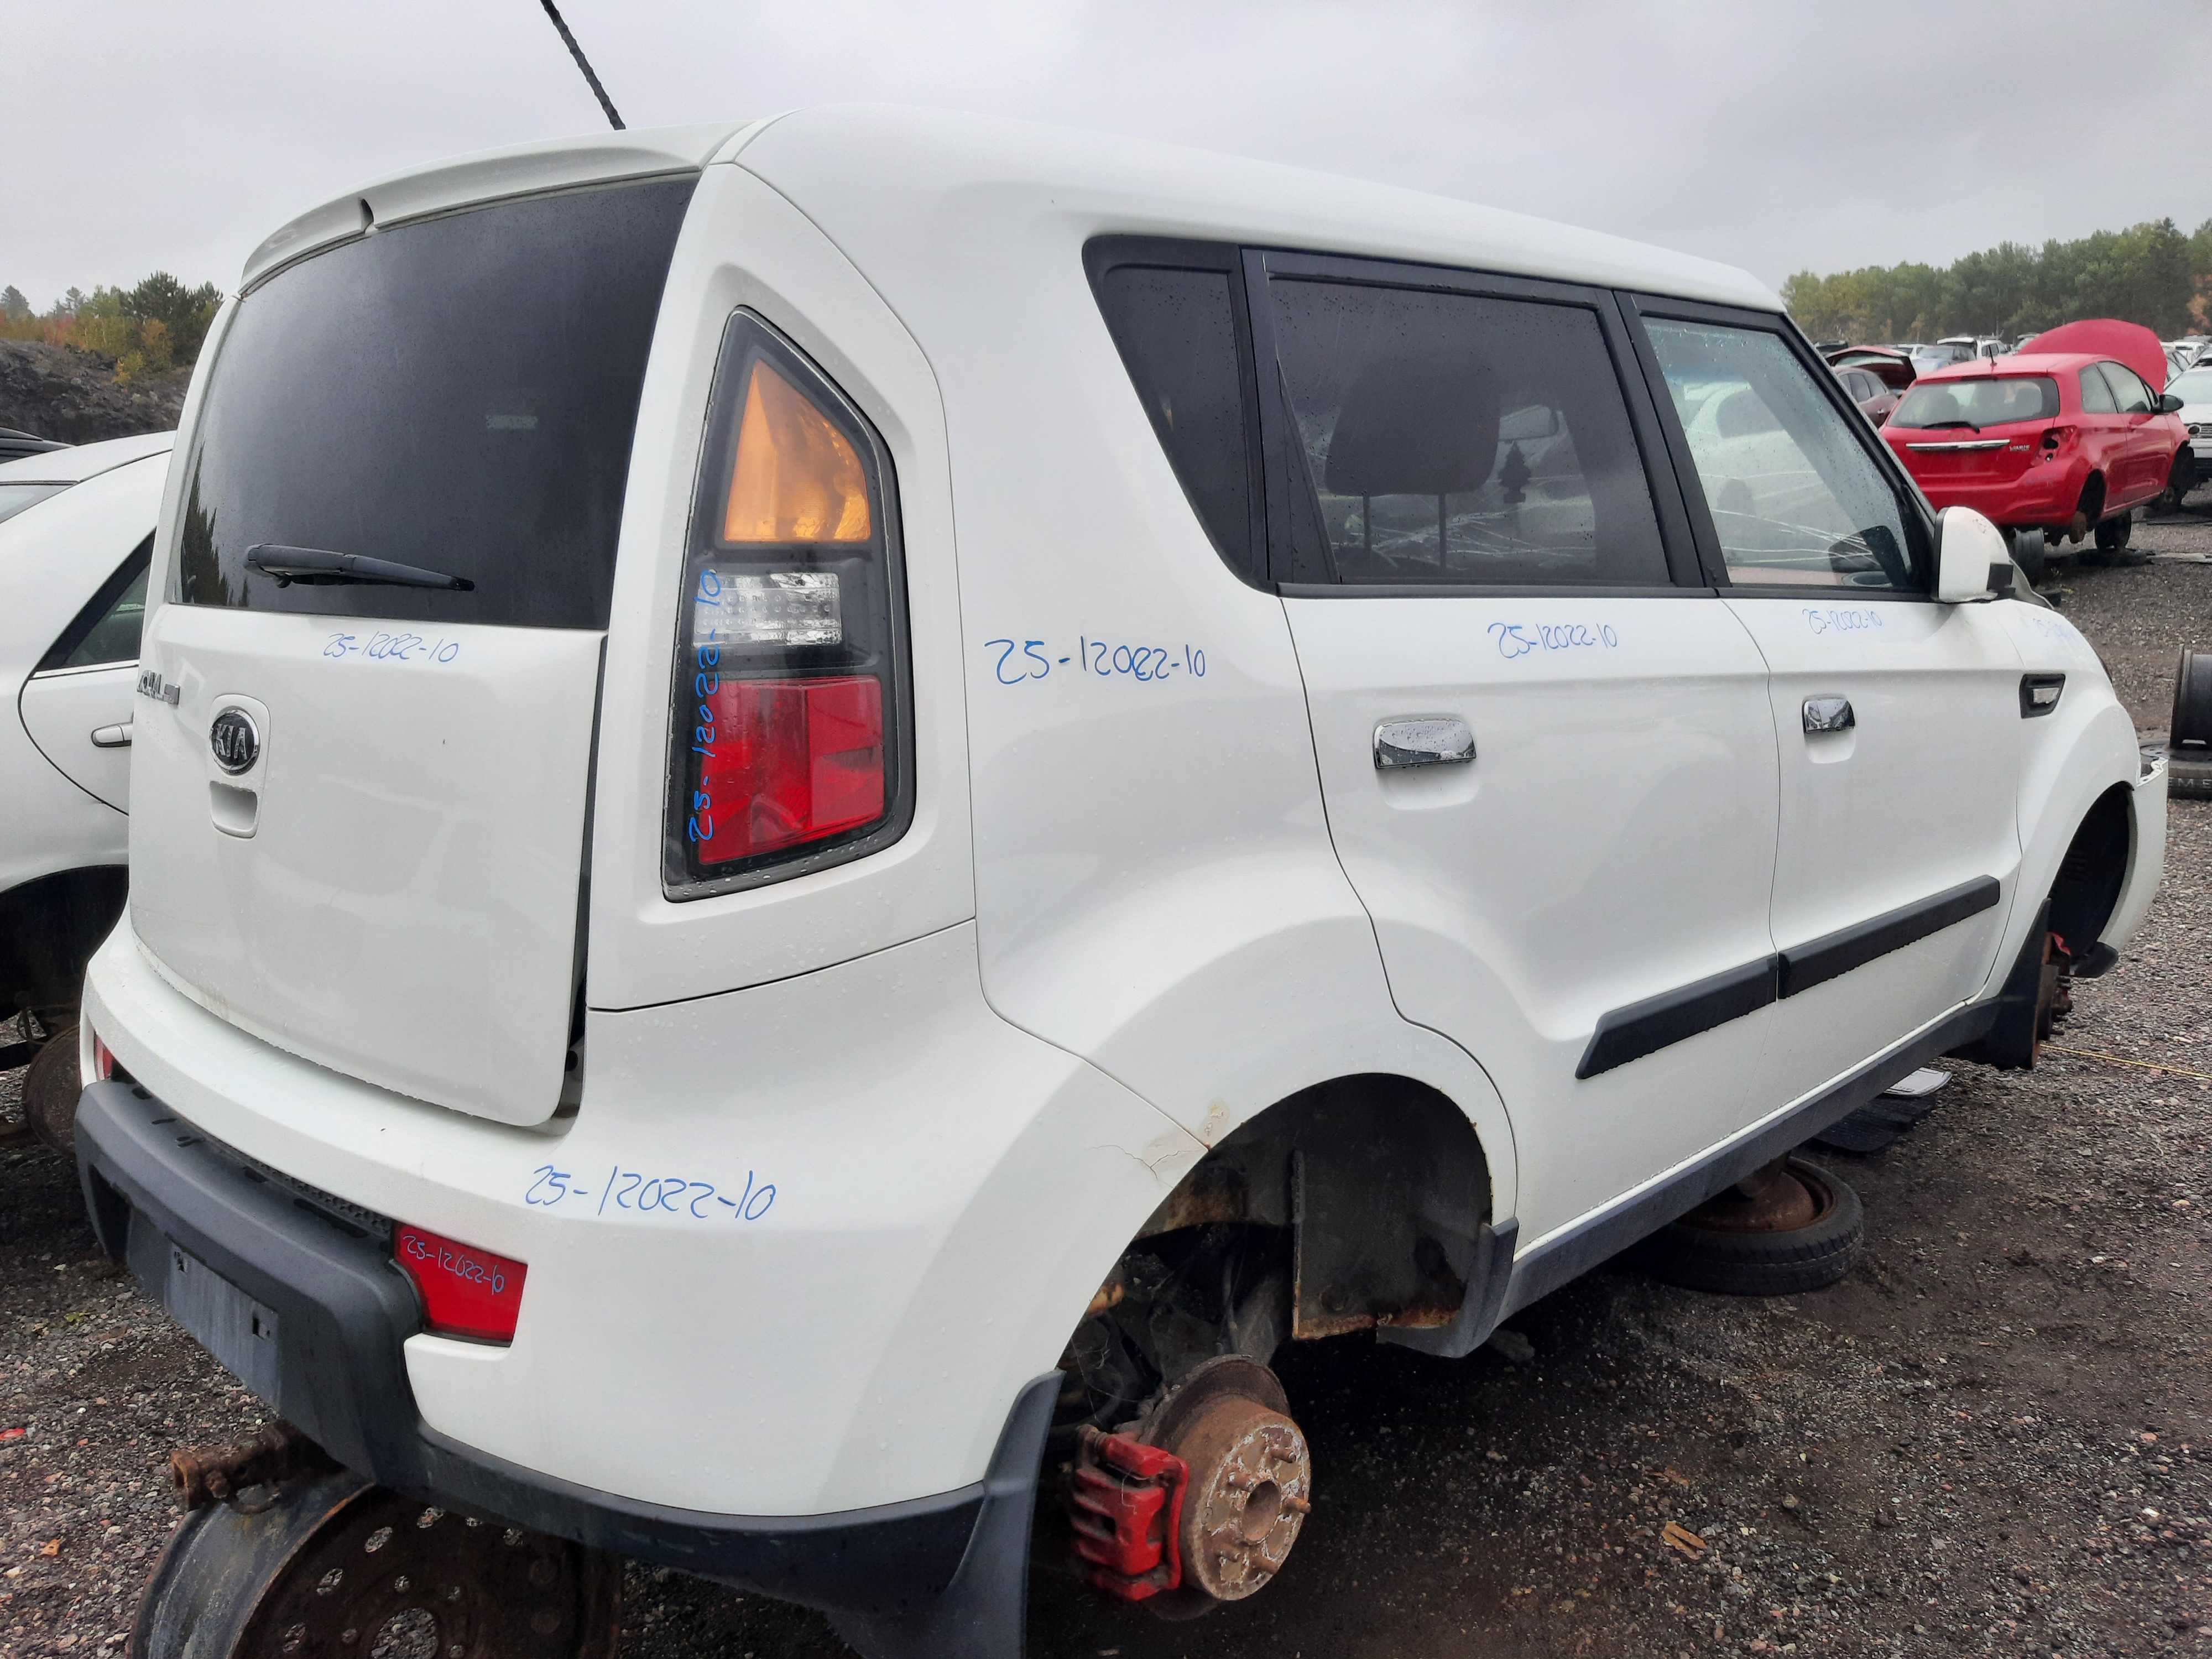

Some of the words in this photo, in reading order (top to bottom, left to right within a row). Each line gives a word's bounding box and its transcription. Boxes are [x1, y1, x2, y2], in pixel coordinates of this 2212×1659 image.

[324, 630, 459, 662] 25-12022-10
[984, 635, 1206, 685] 25-12022-10
[1488, 622, 1618, 659] 25-12022-10
[215, 723, 248, 760] KIA
[525, 1165, 777, 1220] 25-12022-10
[403, 1235, 505, 1296] 25-12022-10
